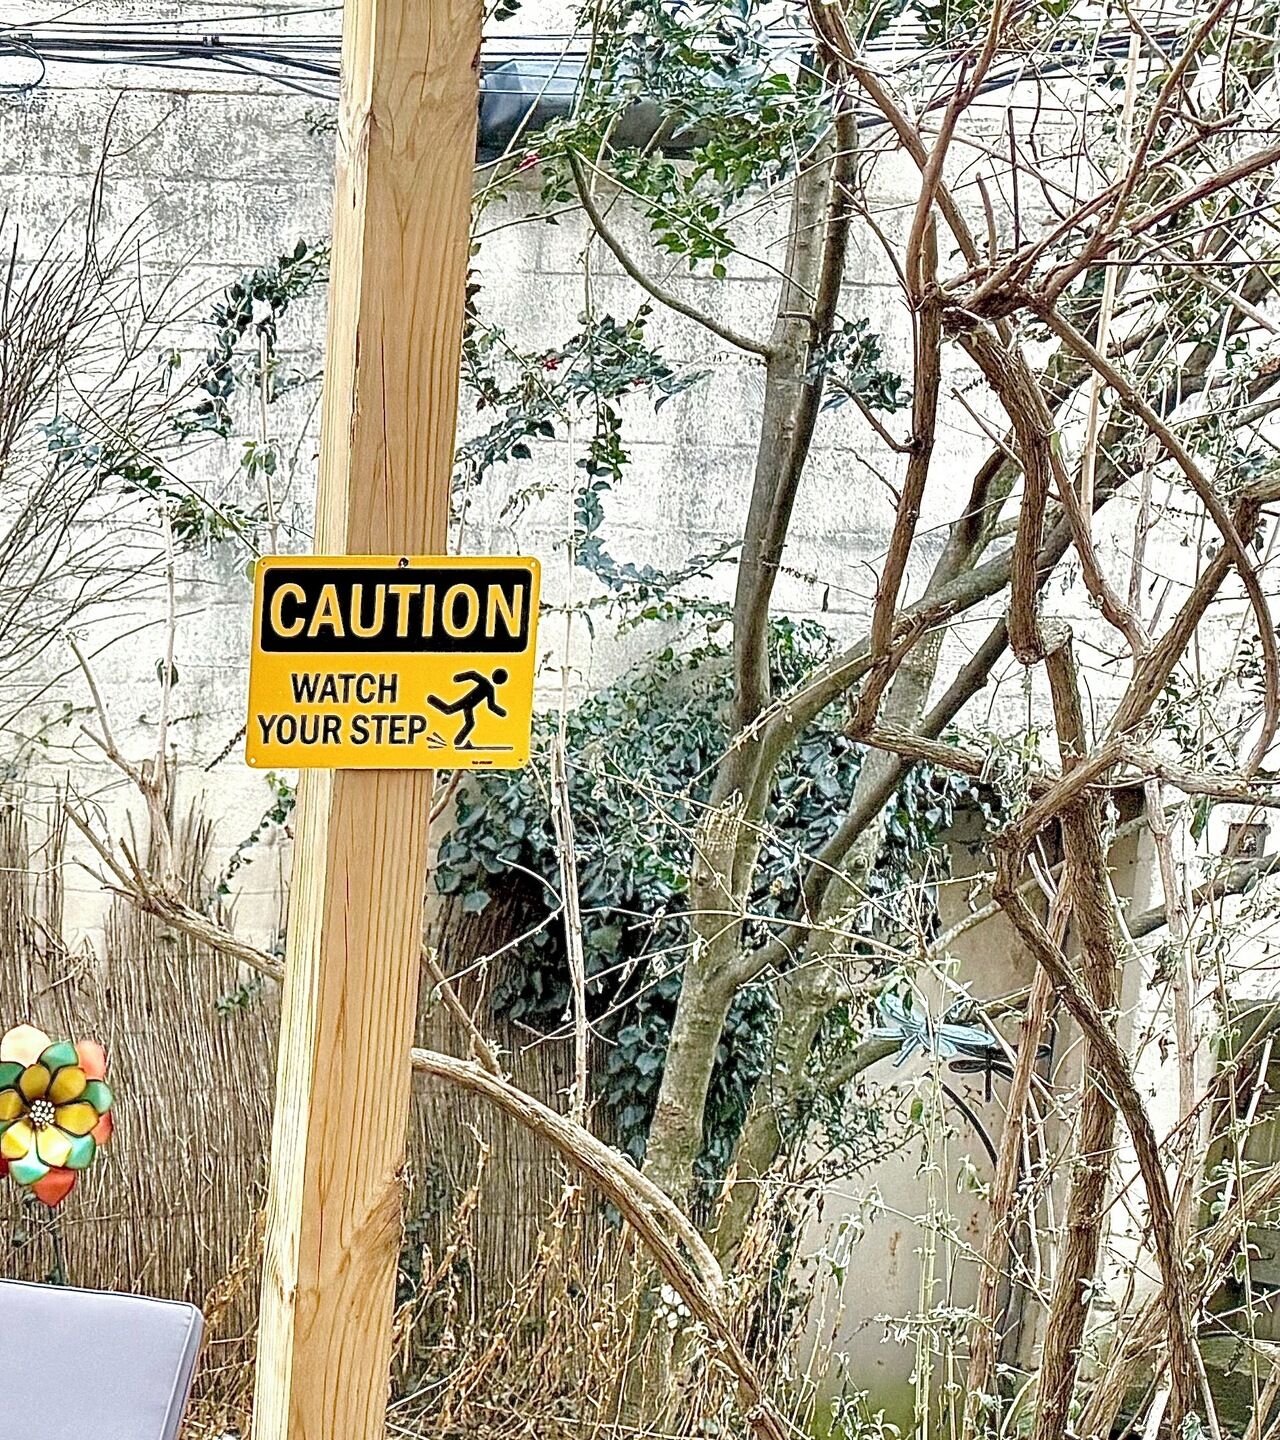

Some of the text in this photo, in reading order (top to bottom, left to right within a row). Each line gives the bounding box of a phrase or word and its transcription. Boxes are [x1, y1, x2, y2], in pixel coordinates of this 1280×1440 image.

[270, 583, 524, 638] CAUTION
[291, 673, 398, 704] WATCH
[258, 714, 427, 745] YOUR STEP
